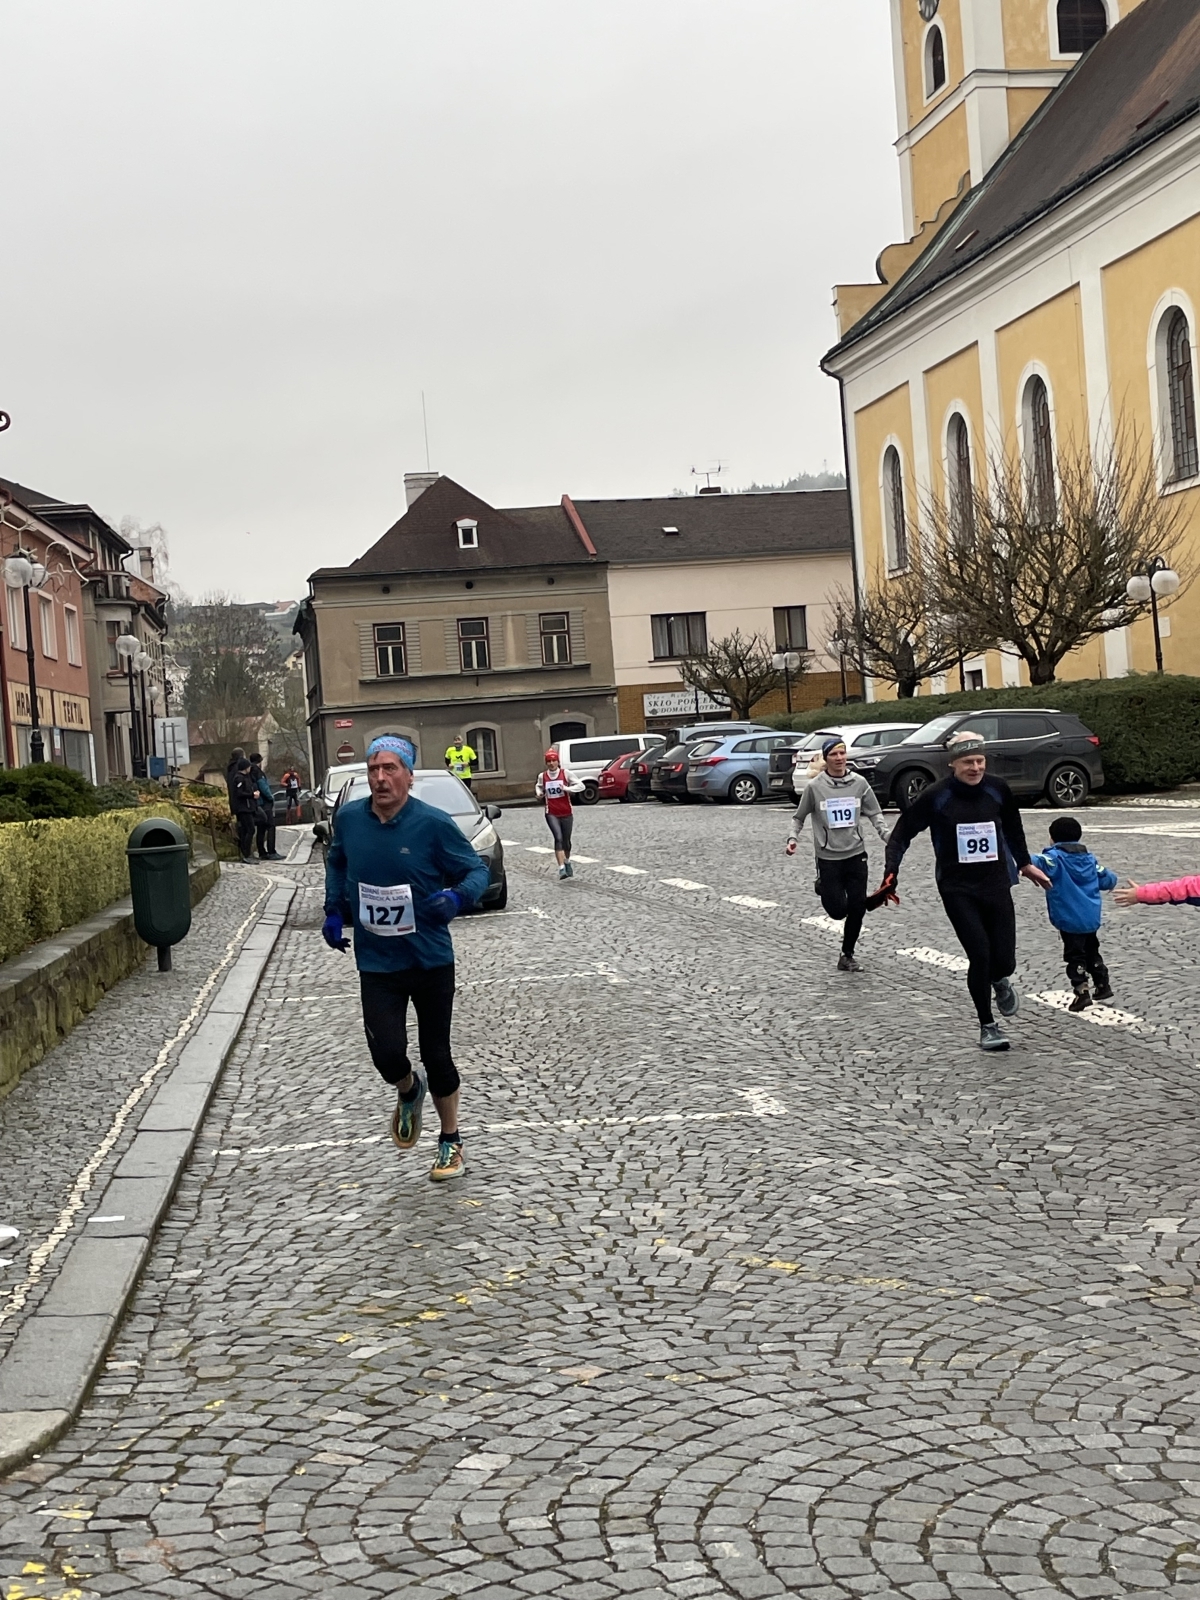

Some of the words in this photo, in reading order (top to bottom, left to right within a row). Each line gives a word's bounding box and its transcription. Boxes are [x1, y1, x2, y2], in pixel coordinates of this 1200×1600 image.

[648, 699, 672, 707] SKLO
[63, 700, 83, 724] TEXTIL
[548, 787, 561, 795] 120
[832, 809, 852, 821] 119
[967, 838, 990, 854] 98
[366, 905, 405, 925] 127
